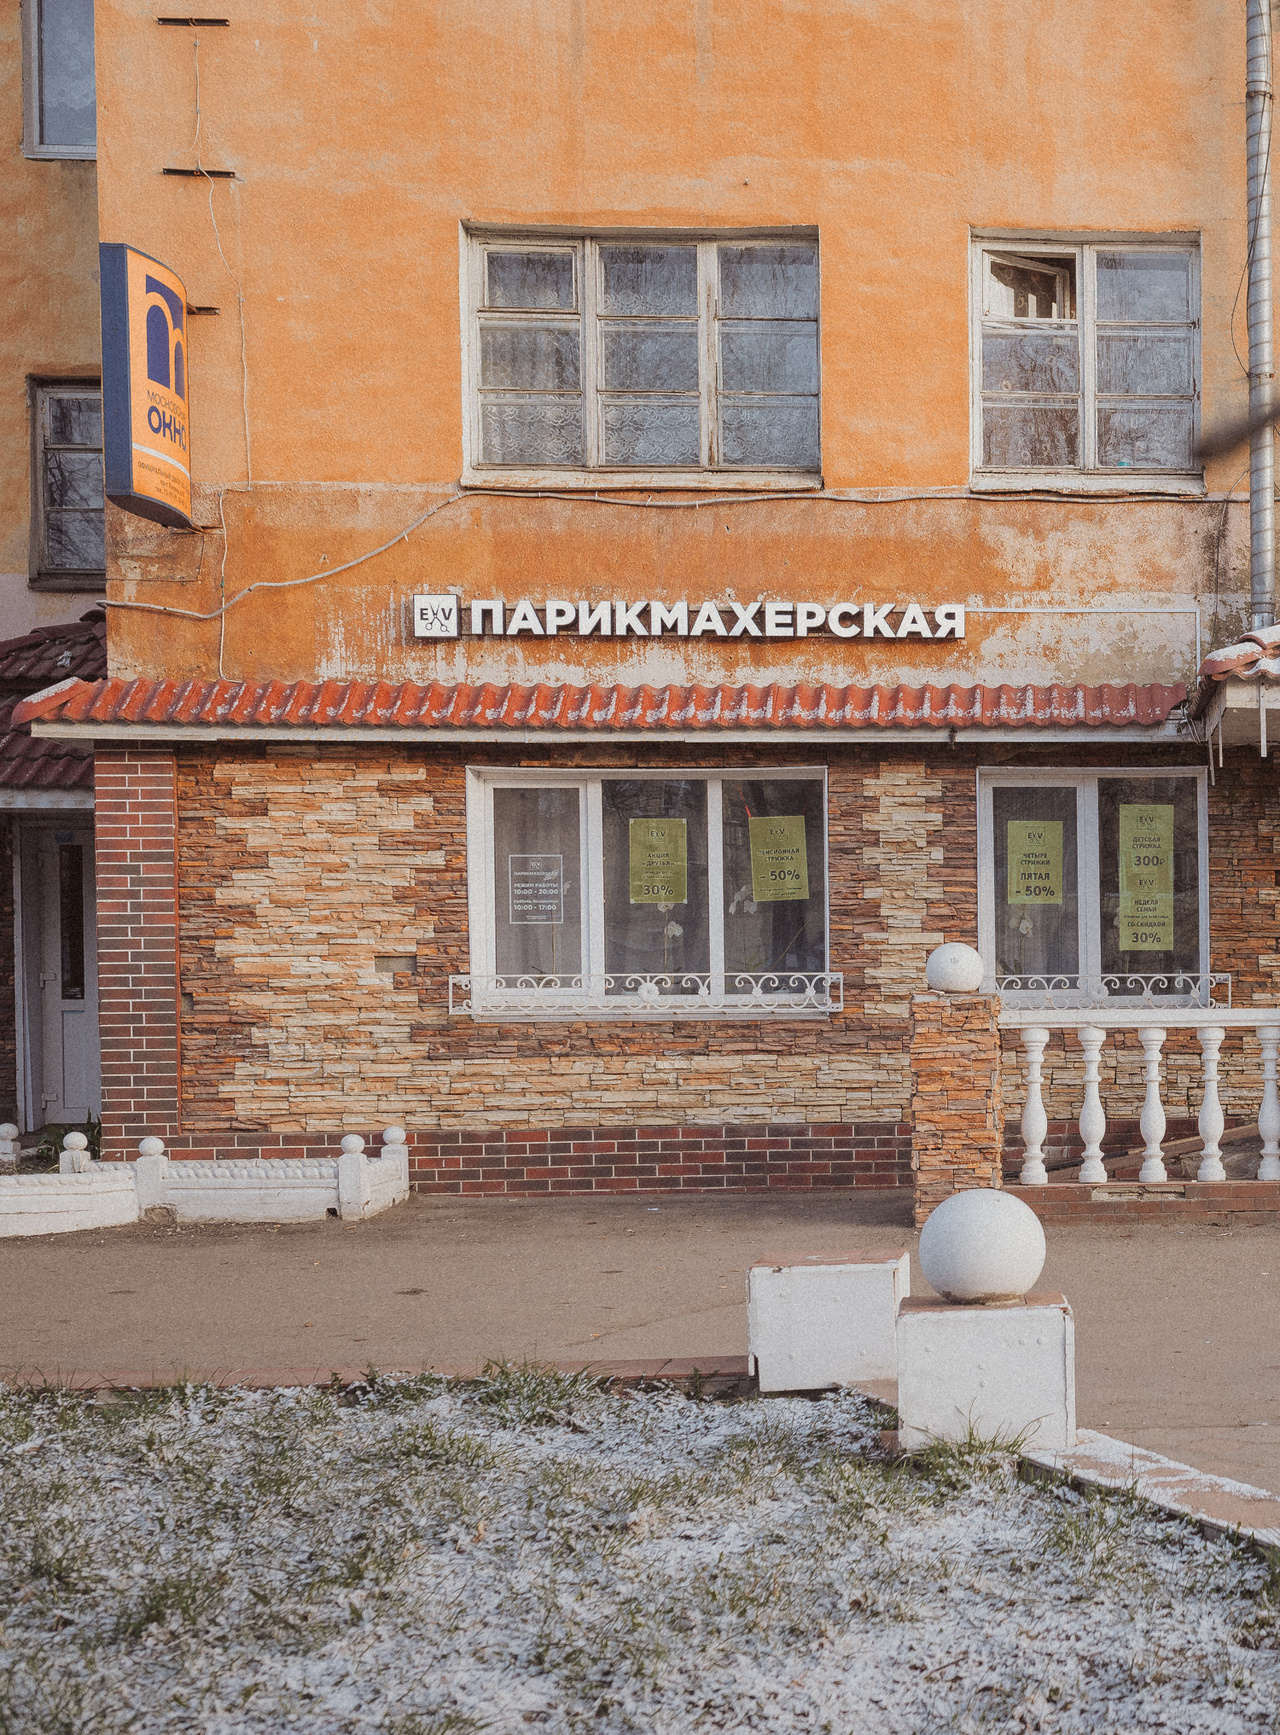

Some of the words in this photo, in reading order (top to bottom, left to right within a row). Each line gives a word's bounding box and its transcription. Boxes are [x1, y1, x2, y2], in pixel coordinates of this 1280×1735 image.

[471, 599, 966, 639] ПАРИКМАХЕРСКАЯ
[757, 848, 800, 856] ПЕНСИОННАЯ
[763, 855, 795, 863] СТРИЖКА
[770, 870, 800, 881] 50%
[1020, 873, 1050, 881] ПЯТАЯ
[643, 885, 674, 896] 30%
[1025, 885, 1055, 897] 50%
[1131, 932, 1162, 943] 30%
